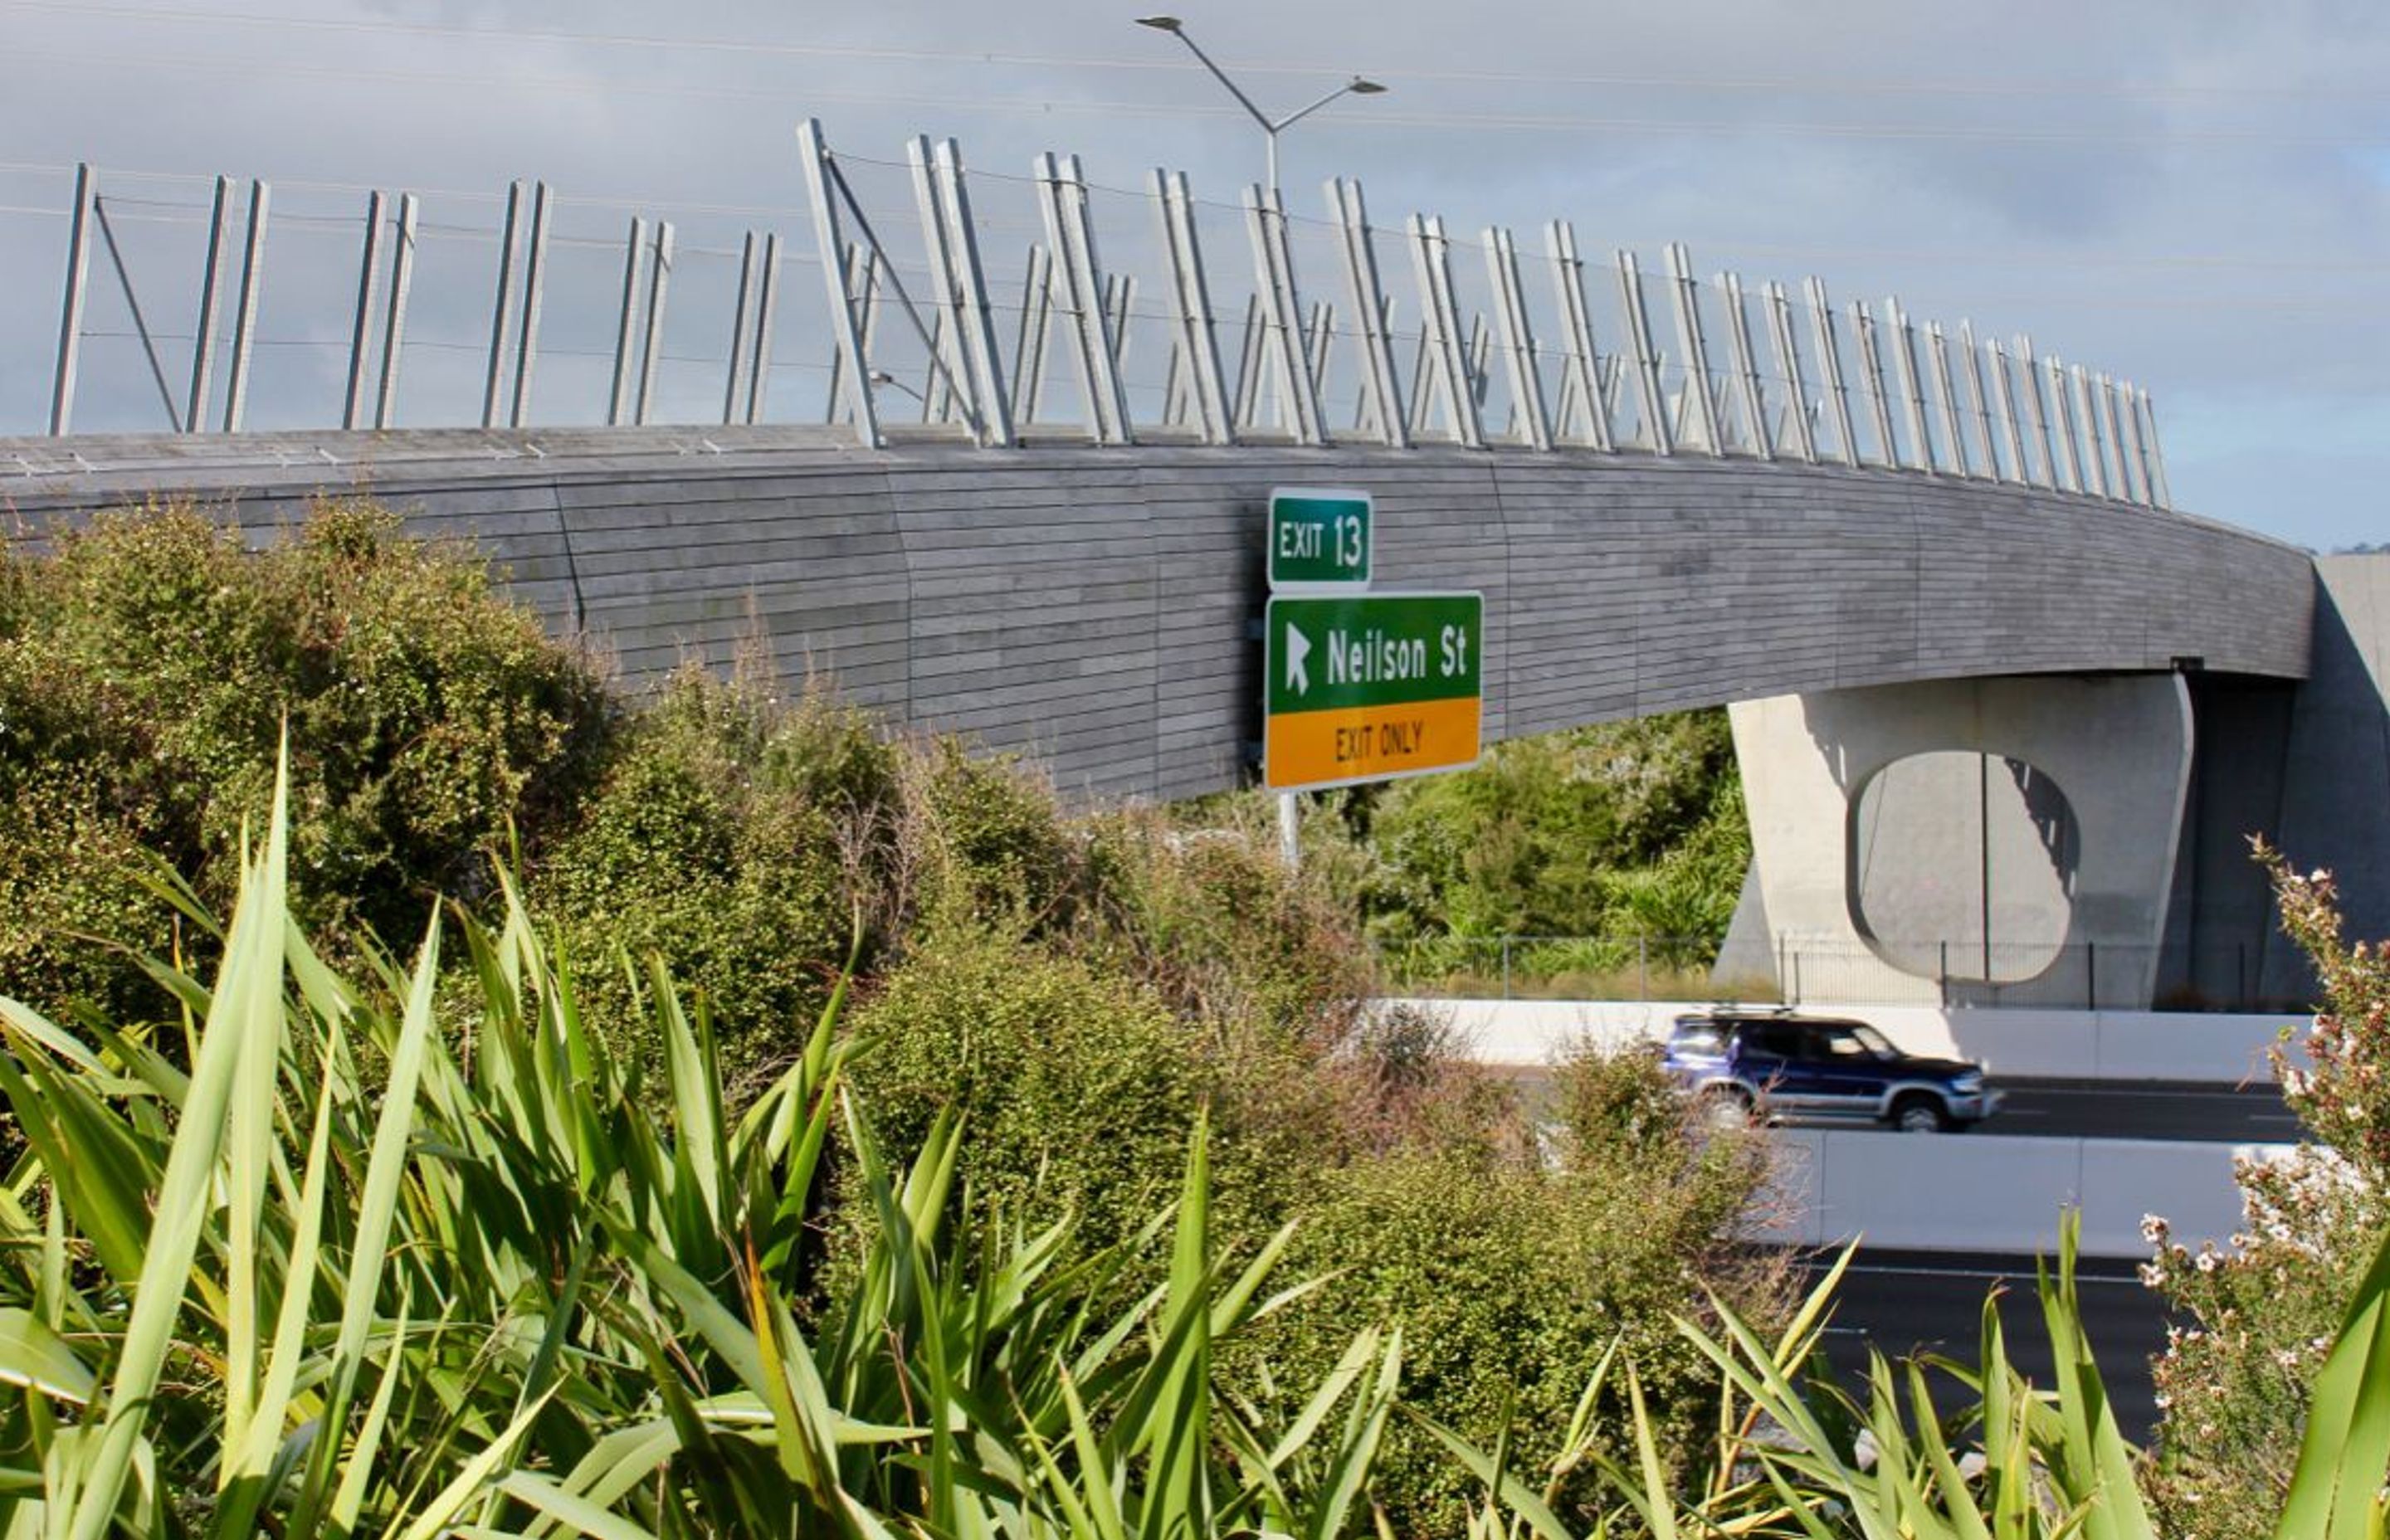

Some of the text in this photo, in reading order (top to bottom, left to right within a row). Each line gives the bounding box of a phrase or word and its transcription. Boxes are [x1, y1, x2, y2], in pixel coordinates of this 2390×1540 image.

[1280, 514, 1363, 567] EXIT 13
[1326, 624, 1467, 685] Neilson St
[1335, 722, 1423, 762] EXIT ONLY
